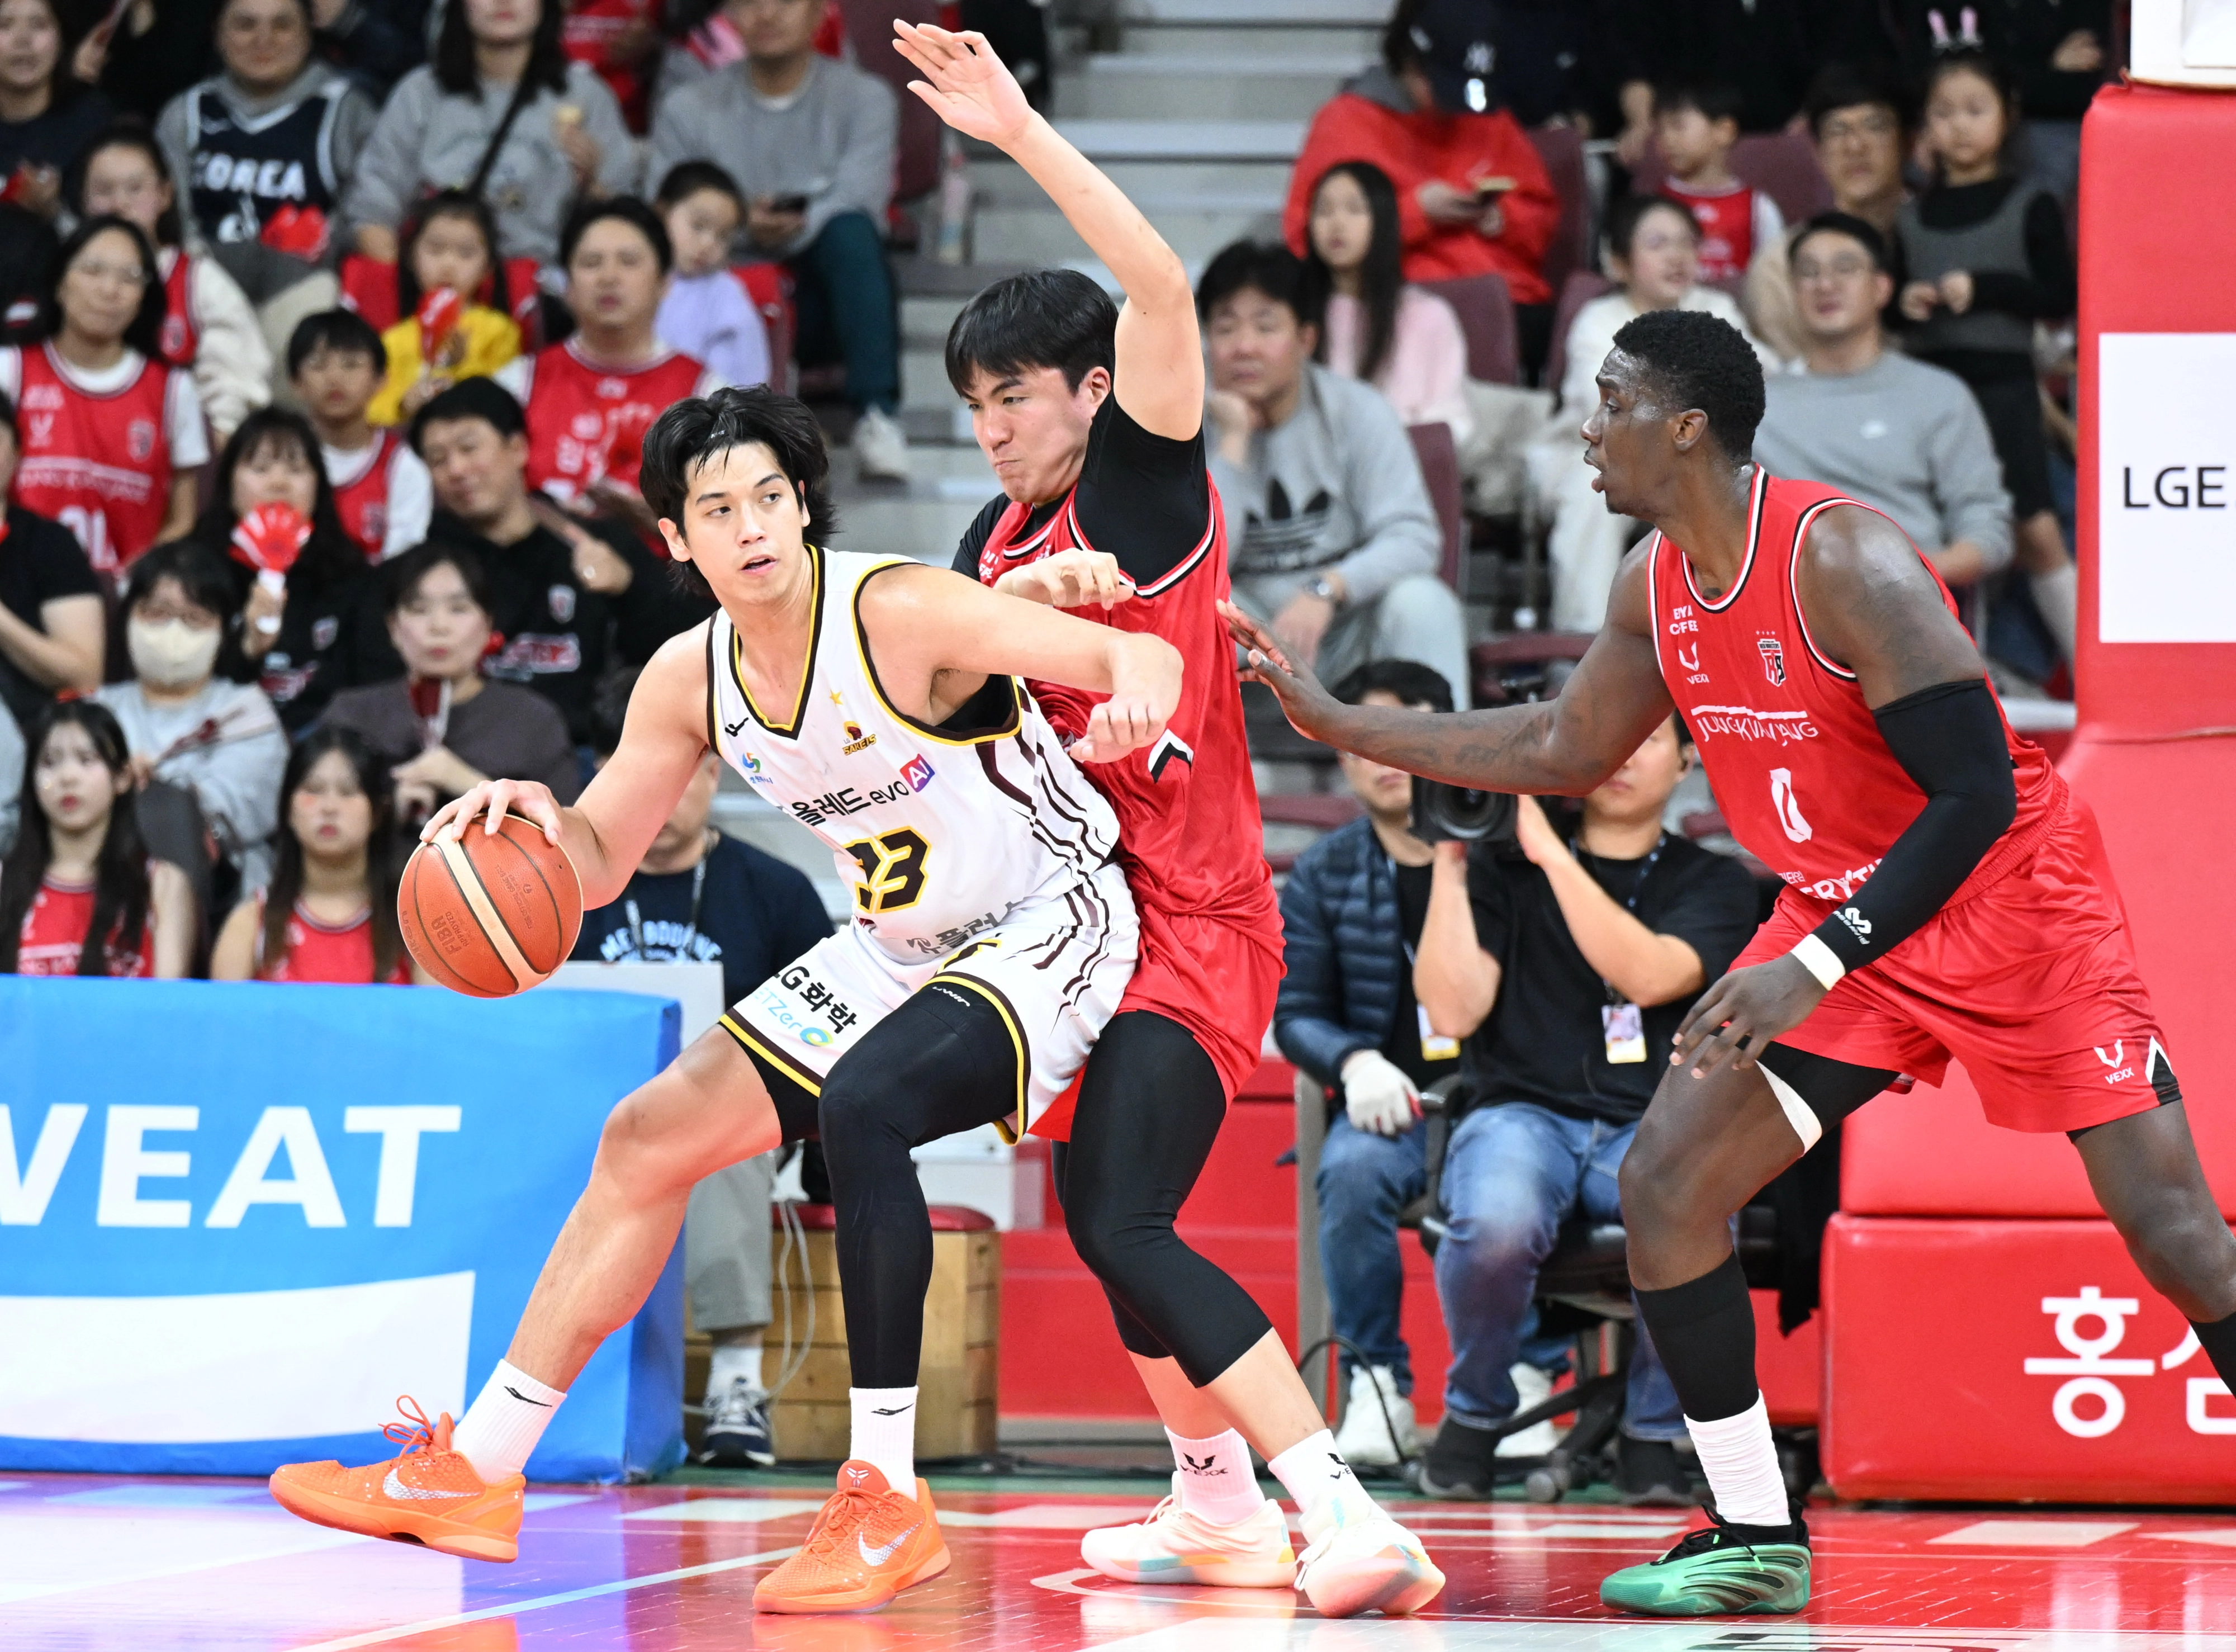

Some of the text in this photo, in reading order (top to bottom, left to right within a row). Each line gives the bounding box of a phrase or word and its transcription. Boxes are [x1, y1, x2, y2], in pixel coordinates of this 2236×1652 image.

[792, 759, 930, 826] 올레드 evo AI
[431, 915, 462, 955] FIBA
[445, 911, 470, 947] APPROVED
[600, 920, 722, 963] MEBOURNE
